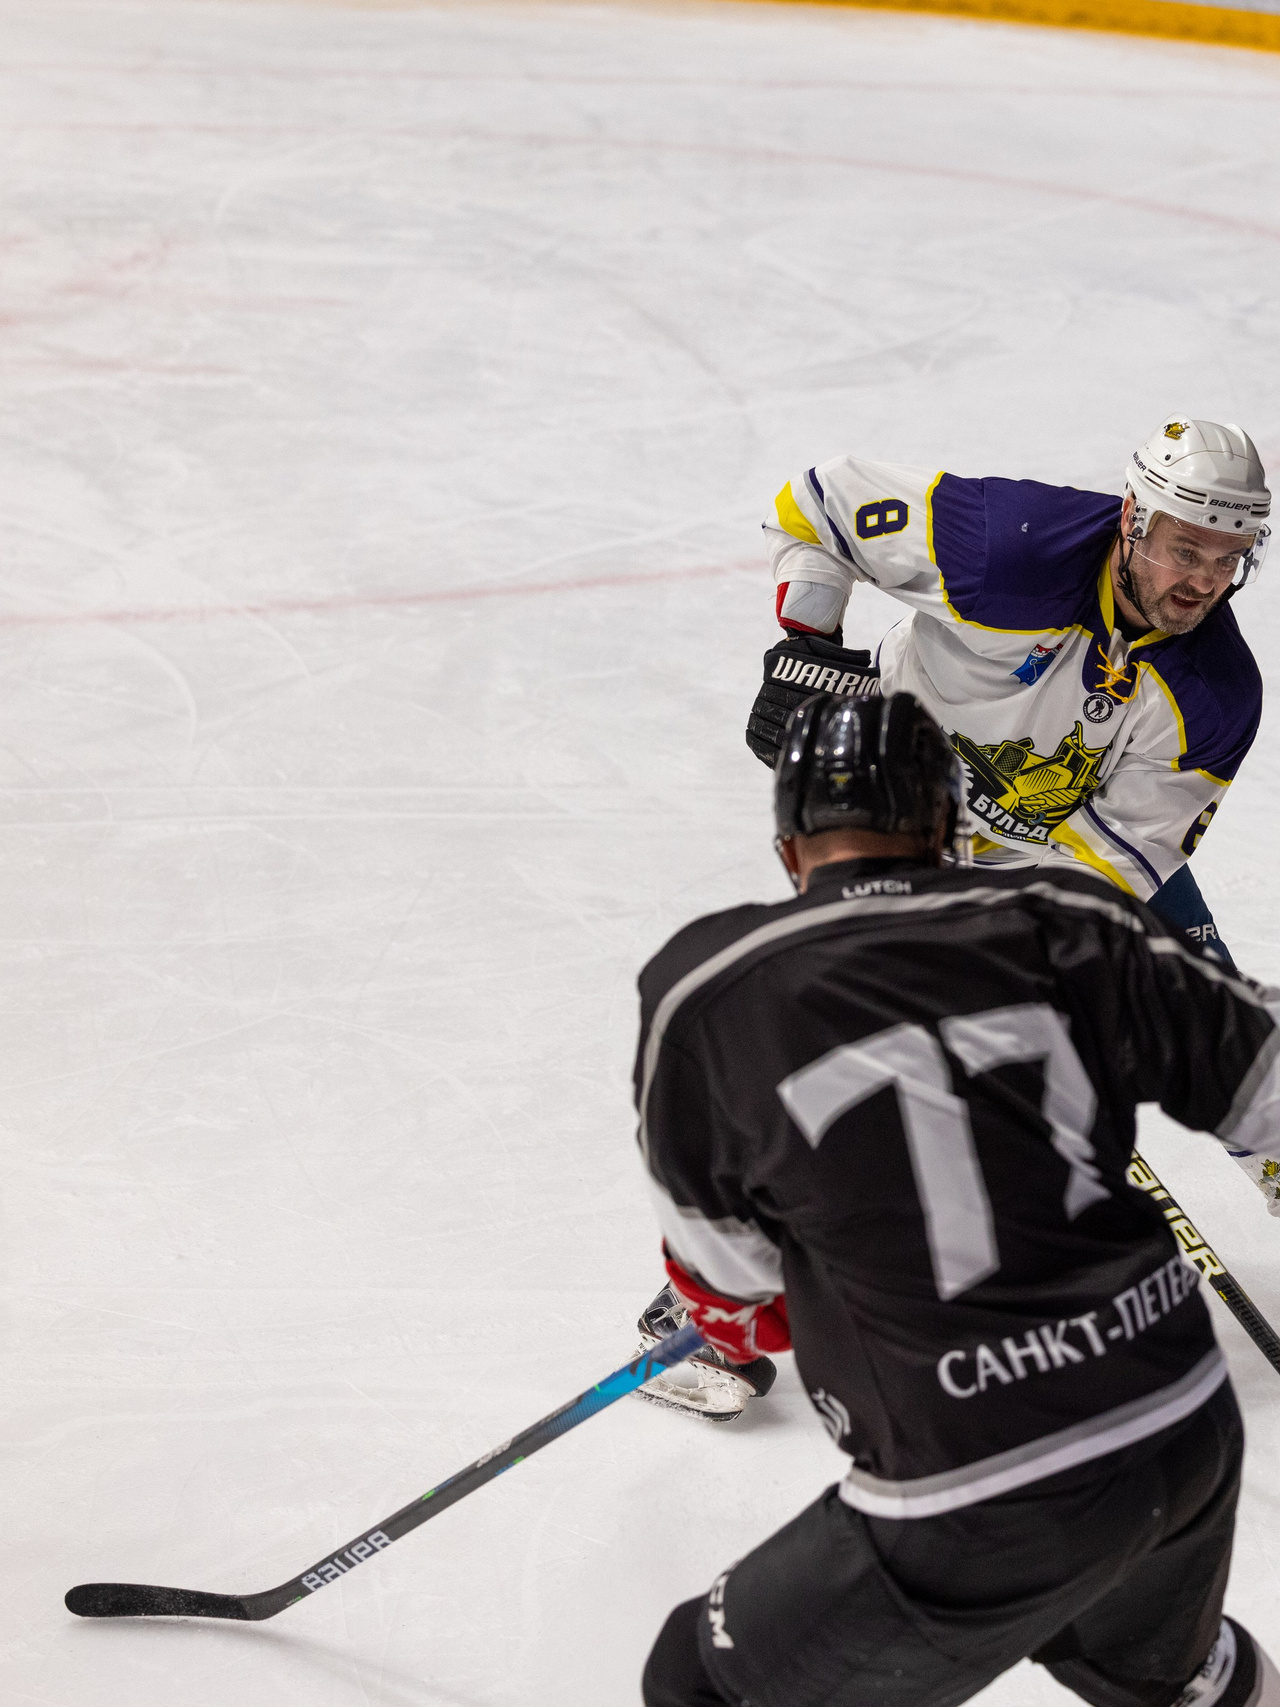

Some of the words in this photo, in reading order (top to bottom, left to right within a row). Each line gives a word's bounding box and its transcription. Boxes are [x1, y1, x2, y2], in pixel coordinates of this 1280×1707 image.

[855, 497, 909, 541] 8
[1208, 498, 1251, 513] BAUER
[771, 655, 881, 697] WARRIO
[777, 1002, 1114, 1301] 77
[708, 1570, 735, 1650] CM
